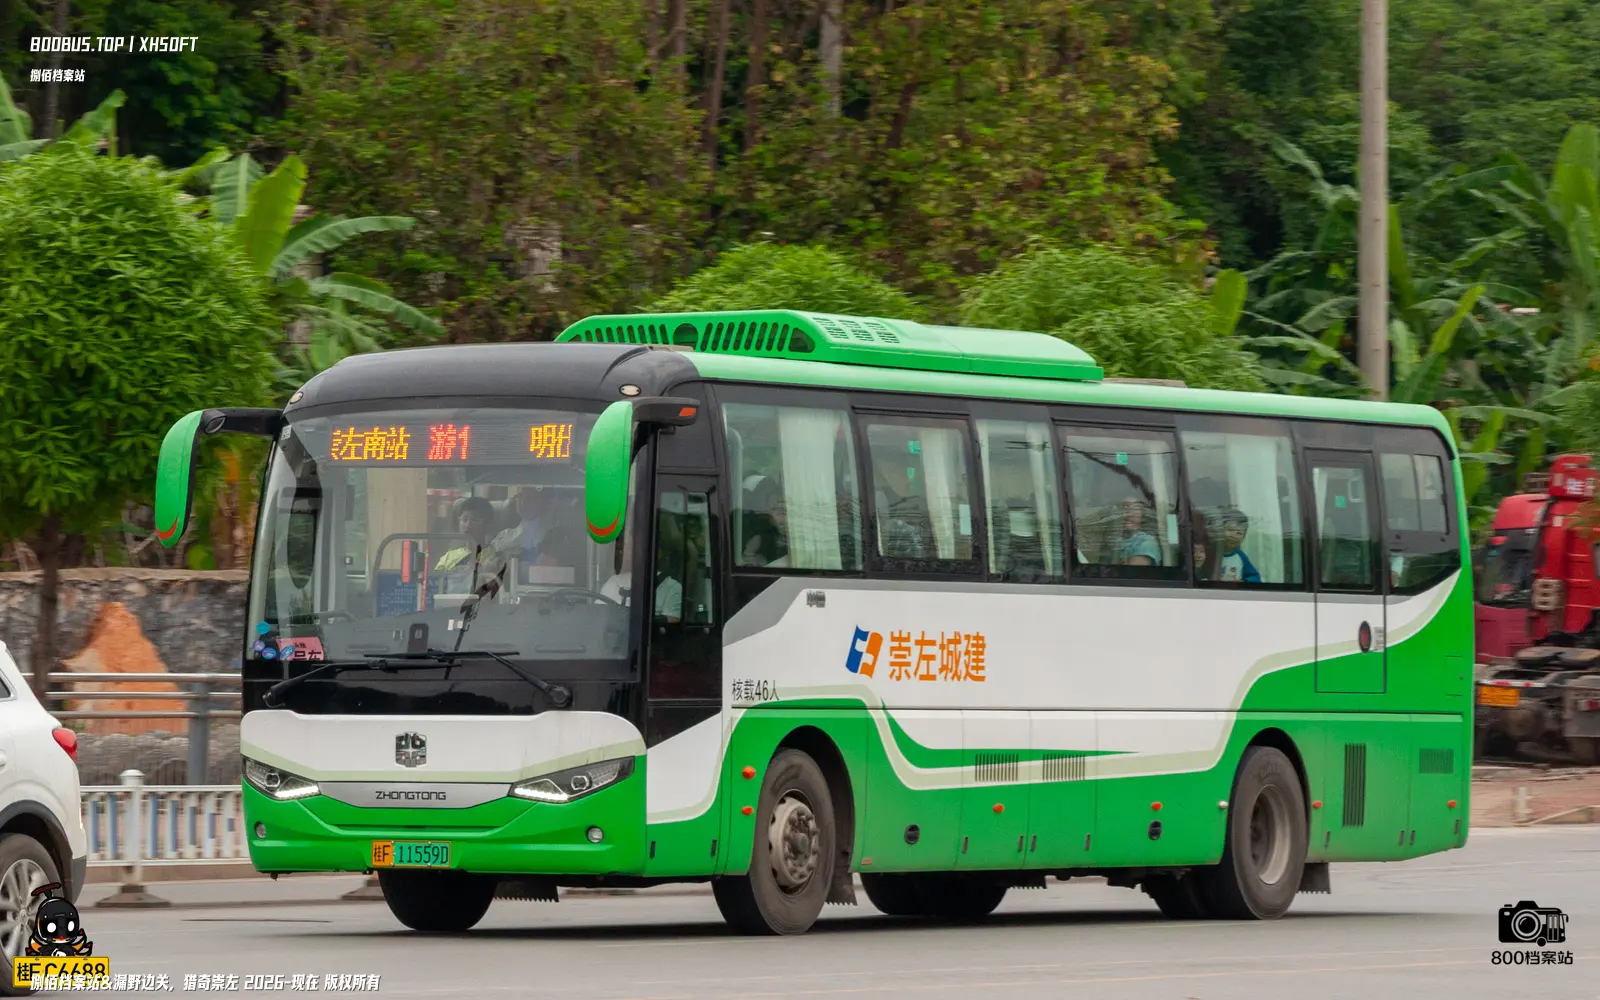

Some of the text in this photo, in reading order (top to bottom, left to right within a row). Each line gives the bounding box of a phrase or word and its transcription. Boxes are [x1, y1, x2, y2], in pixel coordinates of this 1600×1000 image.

[889, 630, 987, 682] 崇左城建
[731, 678, 780, 701] 核载46人
[375, 791, 447, 800] ZHONGTONG
